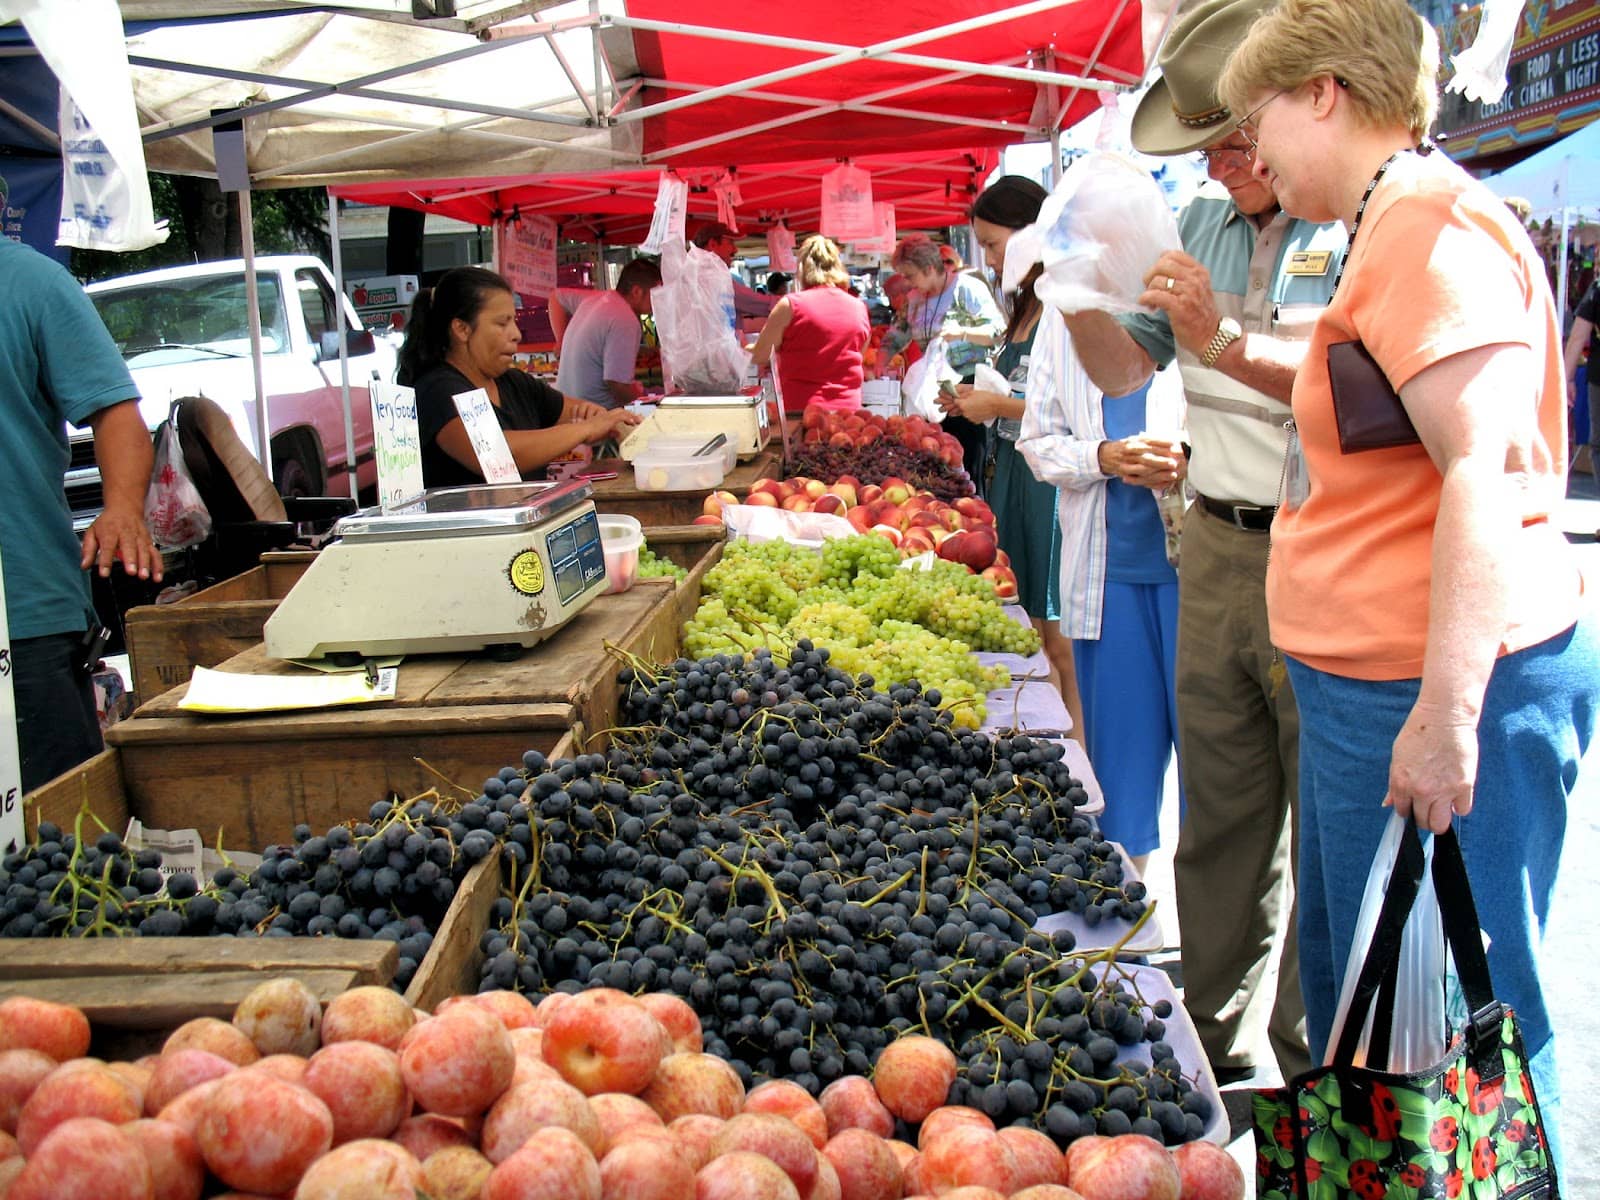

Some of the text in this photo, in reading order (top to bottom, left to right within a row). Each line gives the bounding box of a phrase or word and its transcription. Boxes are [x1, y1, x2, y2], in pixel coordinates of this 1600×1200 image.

[1527, 34, 1599, 81] FOOD 4 LESS
[1480, 62, 1599, 119] CLASSIC CINEMA NIGHT
